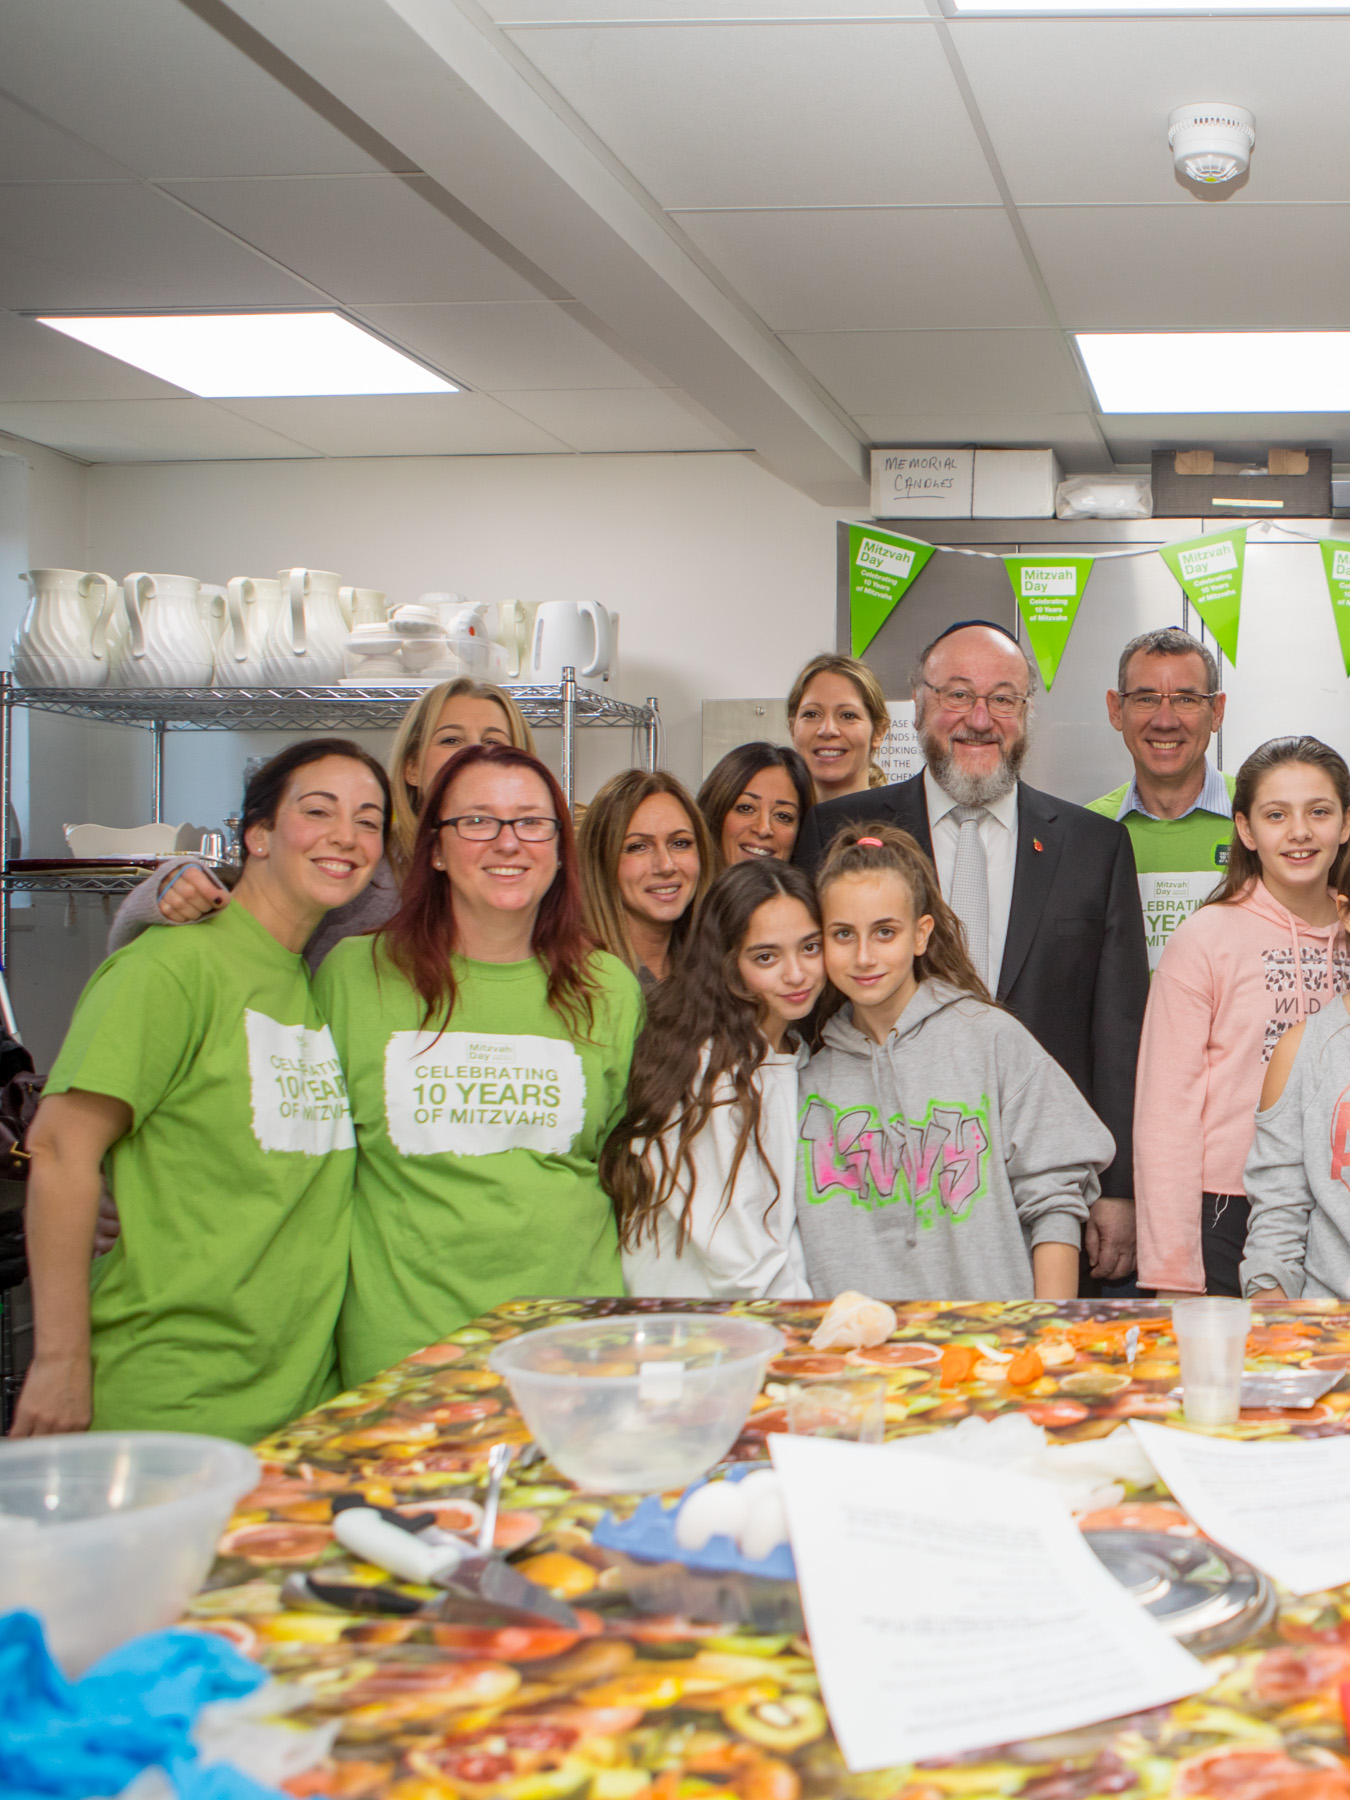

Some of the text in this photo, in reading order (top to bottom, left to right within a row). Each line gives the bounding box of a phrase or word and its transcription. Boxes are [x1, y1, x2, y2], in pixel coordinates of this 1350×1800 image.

[885, 457, 958, 471] MEMORIAL
[863, 541, 911, 563] Mitzvah
[1182, 545, 1231, 564] Mitzvah
[860, 552, 884, 567] Day
[1024, 569, 1073, 580] Mitzvah
[1184, 562, 1208, 575] Day
[861, 569, 898, 586] Celebrating
[873, 581, 890, 591] Years
[1024, 581, 1048, 593] Day
[864, 587, 892, 601] Mitzvahs
[1029, 598, 1068, 606] Celebrating
[881, 760, 910, 768] IN THE
[1156, 881, 1187, 889] Mitzvah
[1156, 888, 1171, 896] Day
[1275, 997, 1321, 1014] WID
[469, 1043, 513, 1053] Mitzvah
[469, 1052, 491, 1061] Day
[415, 1065, 559, 1082] CELEBRATING
[275, 1075, 299, 1099] 10
[413, 1082, 561, 1108] 10 YEARS
[280, 1101, 299, 1119] OF
[414, 1108, 558, 1128] OF MITZVAHS
